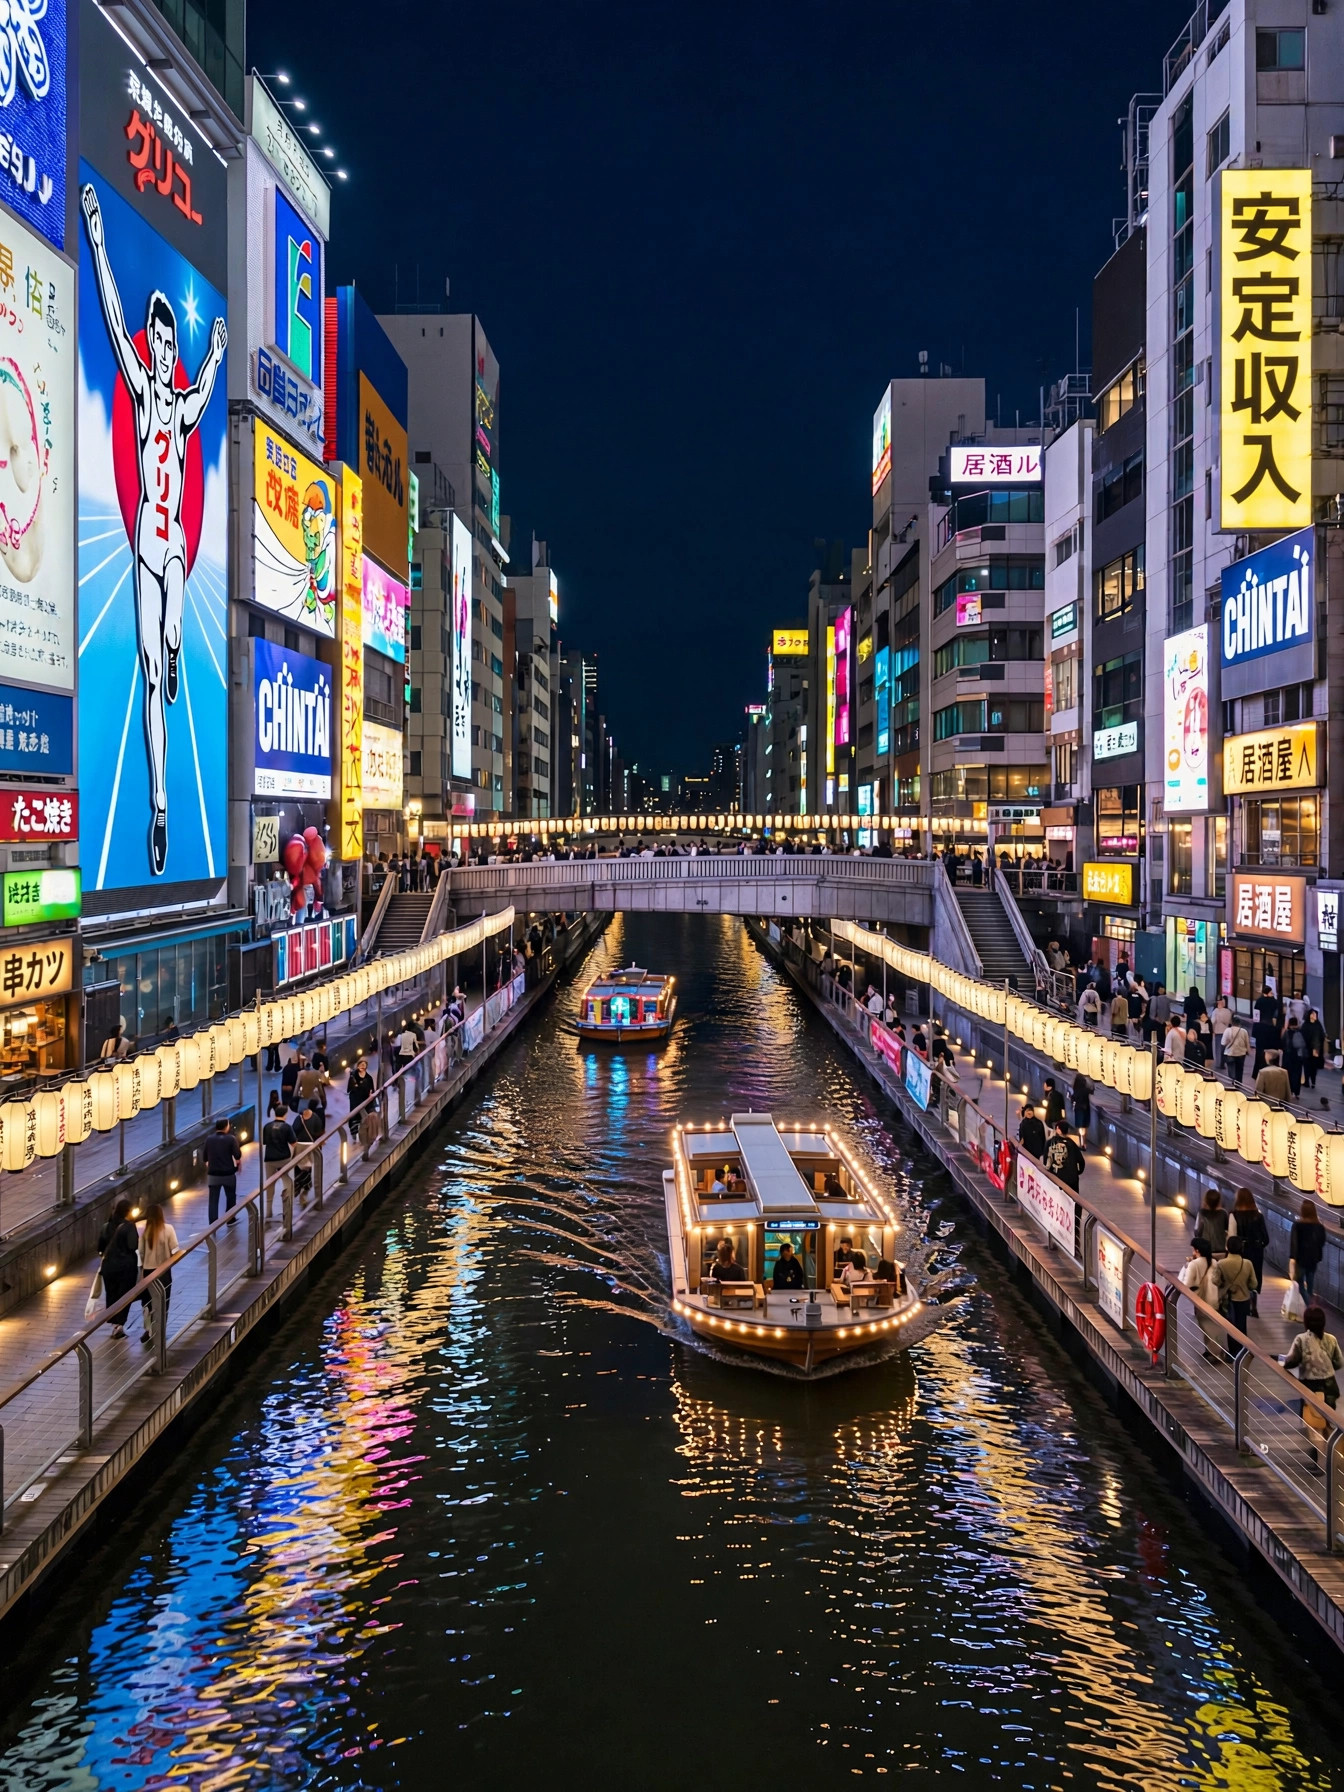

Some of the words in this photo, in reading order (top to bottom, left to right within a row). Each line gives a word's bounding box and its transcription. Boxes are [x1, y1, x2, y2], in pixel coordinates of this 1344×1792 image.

[126, 109, 203, 226] グリコ
[1231, 191, 1302, 504] 安定収入
[154, 429, 172, 542] グリコ
[1223, 544, 1309, 660] CHINTAI
[258, 662, 329, 758] CHINTAI
[11, 795, 72, 833] たこ焼き
[1236, 883, 1292, 933] 居酒屋
[3, 950, 65, 999] 串カツ
